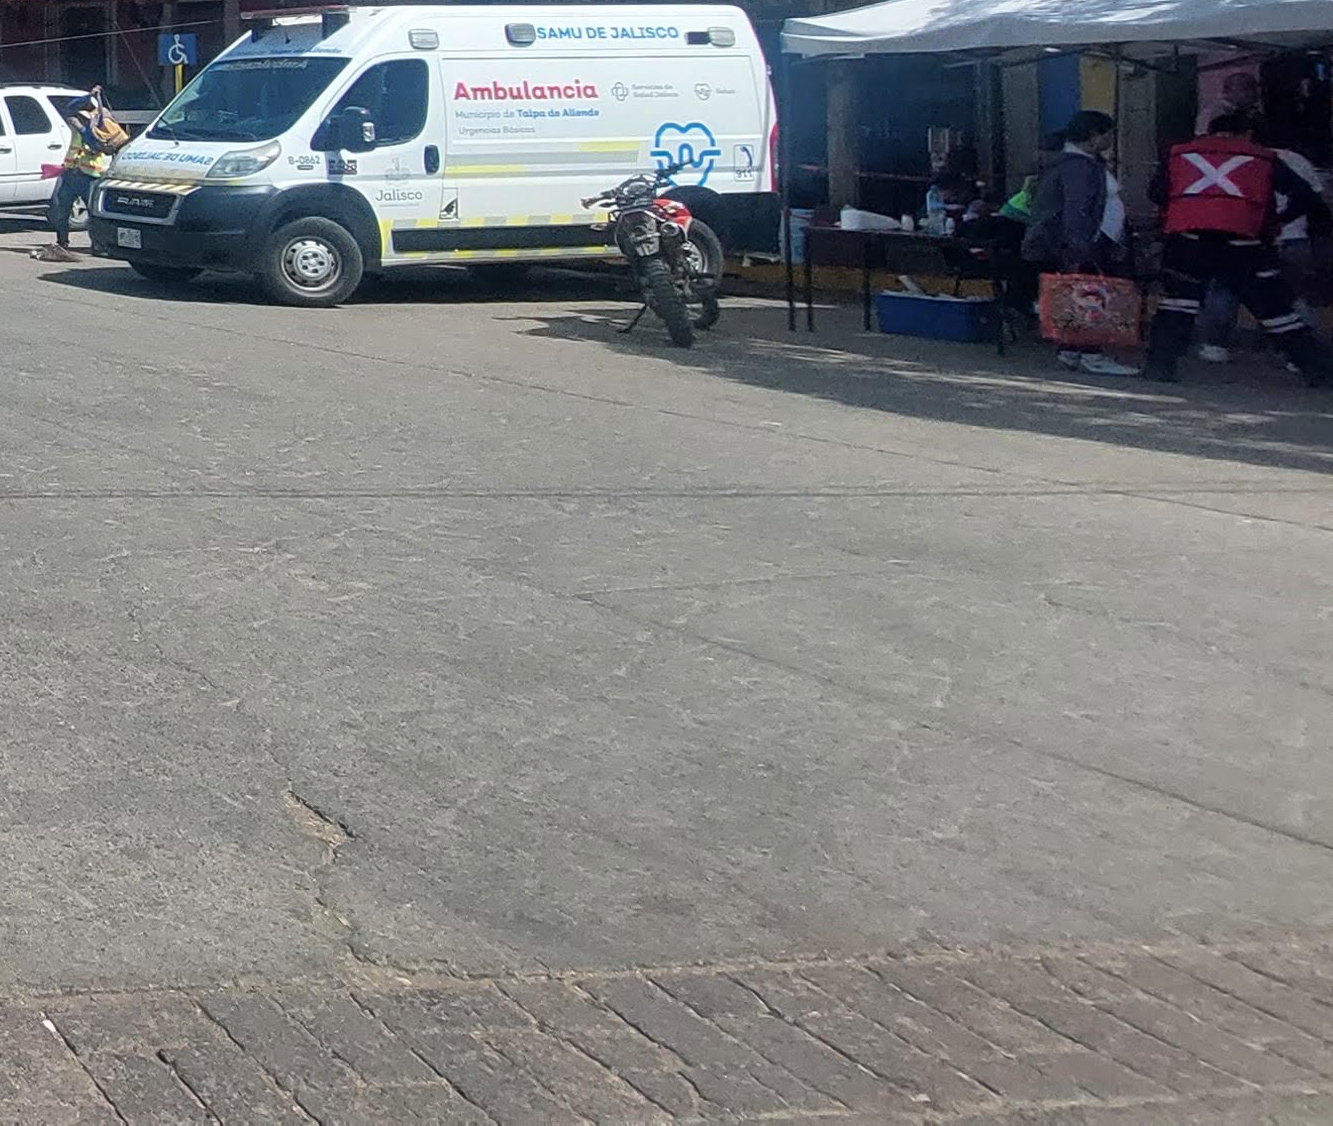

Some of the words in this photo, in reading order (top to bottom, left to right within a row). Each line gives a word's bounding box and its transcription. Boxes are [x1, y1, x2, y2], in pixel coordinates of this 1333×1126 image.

[537, 27, 582, 40] SAMU
[585, 27, 607, 39] DE
[610, 26, 679, 39] JALISCO
[453, 79, 599, 101] Ambulancia
[455, 110, 501, 120] Municipio
[503, 110, 516, 119] de
[517, 109, 546, 120] Talpa
[548, 109, 560, 118] de
[562, 108, 600, 117] Allende
[376, 189, 423, 202] Jalisco
